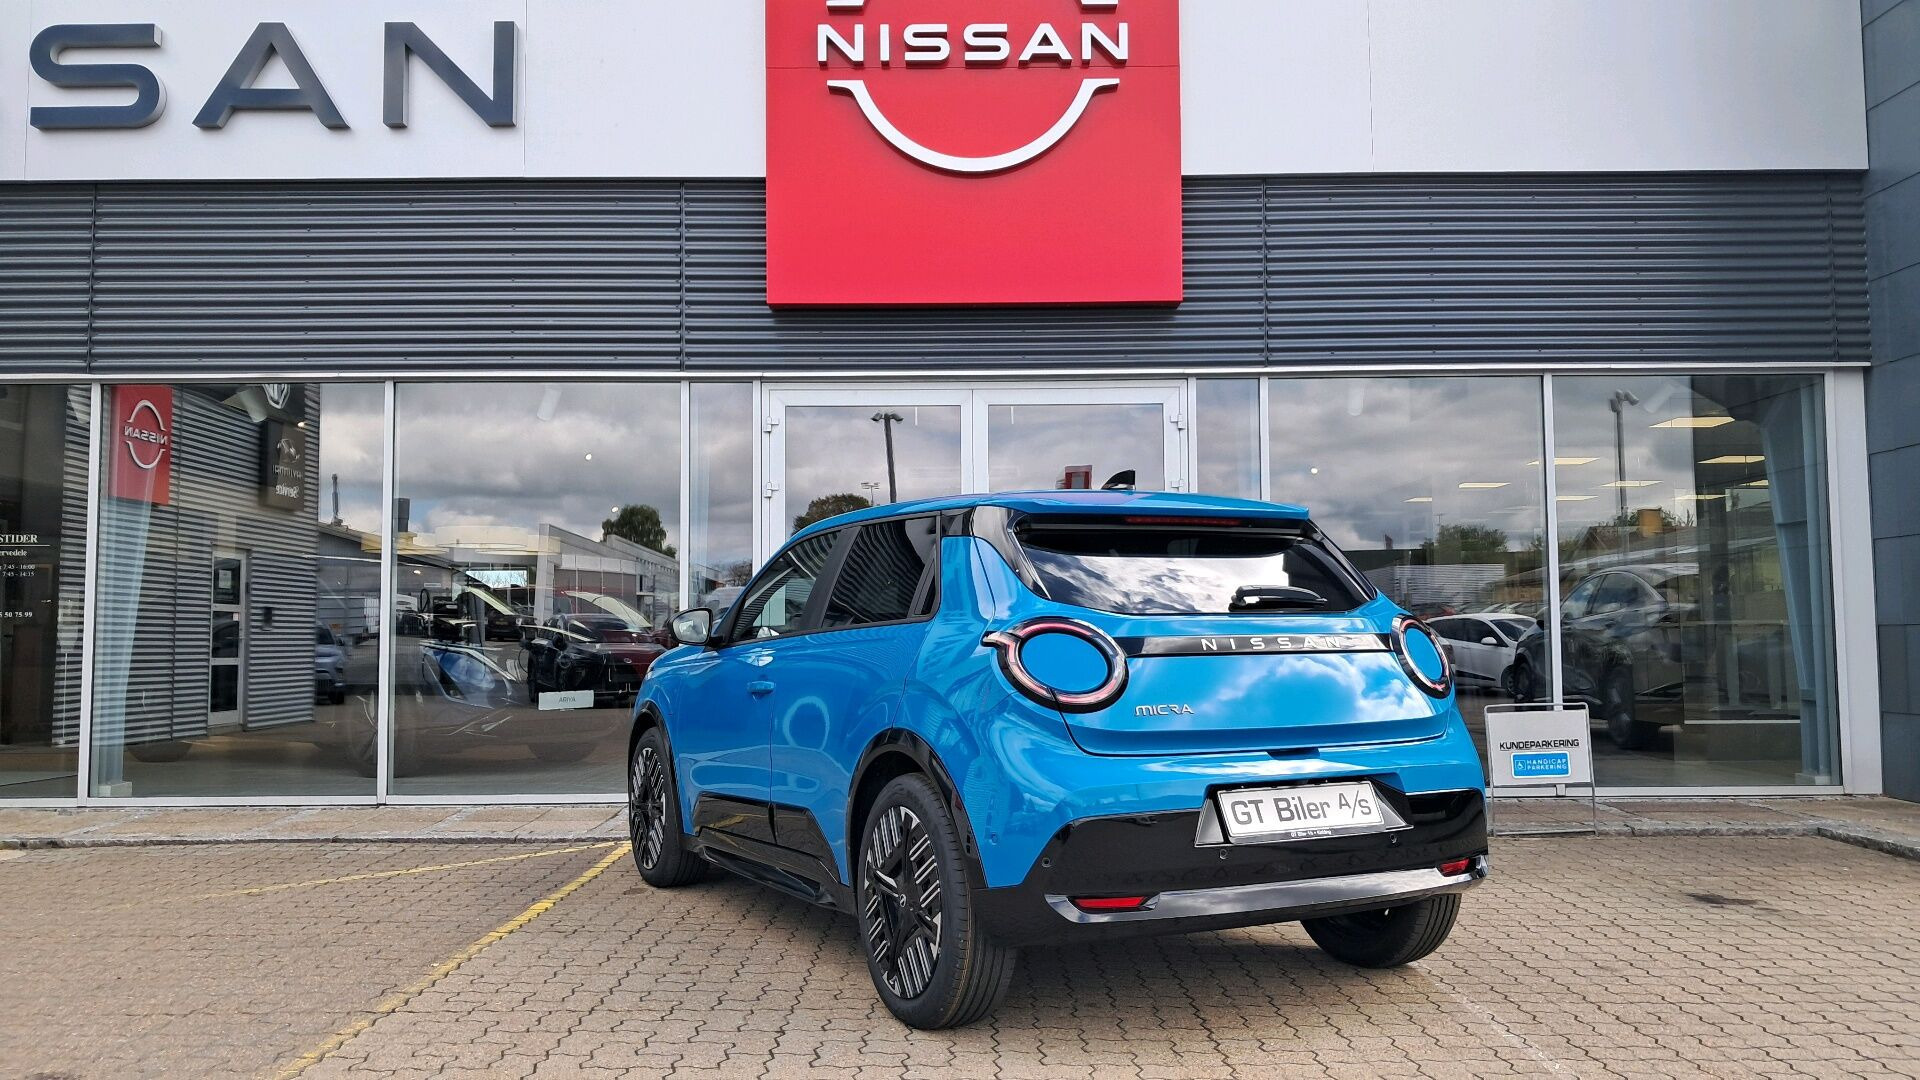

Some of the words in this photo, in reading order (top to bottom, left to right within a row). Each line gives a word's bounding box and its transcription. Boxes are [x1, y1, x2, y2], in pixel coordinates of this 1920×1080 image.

[817, 22, 1129, 65] NISSAN
[29, 21, 519, 129] SAN
[1201, 637, 1341, 651] NISSAN
[1135, 704, 1194, 716] MICRA
[1500, 739, 1580, 750] KUNDEPARKERING
[1230, 799, 1264, 825] GT
[1273, 796, 1331, 822] Biler
